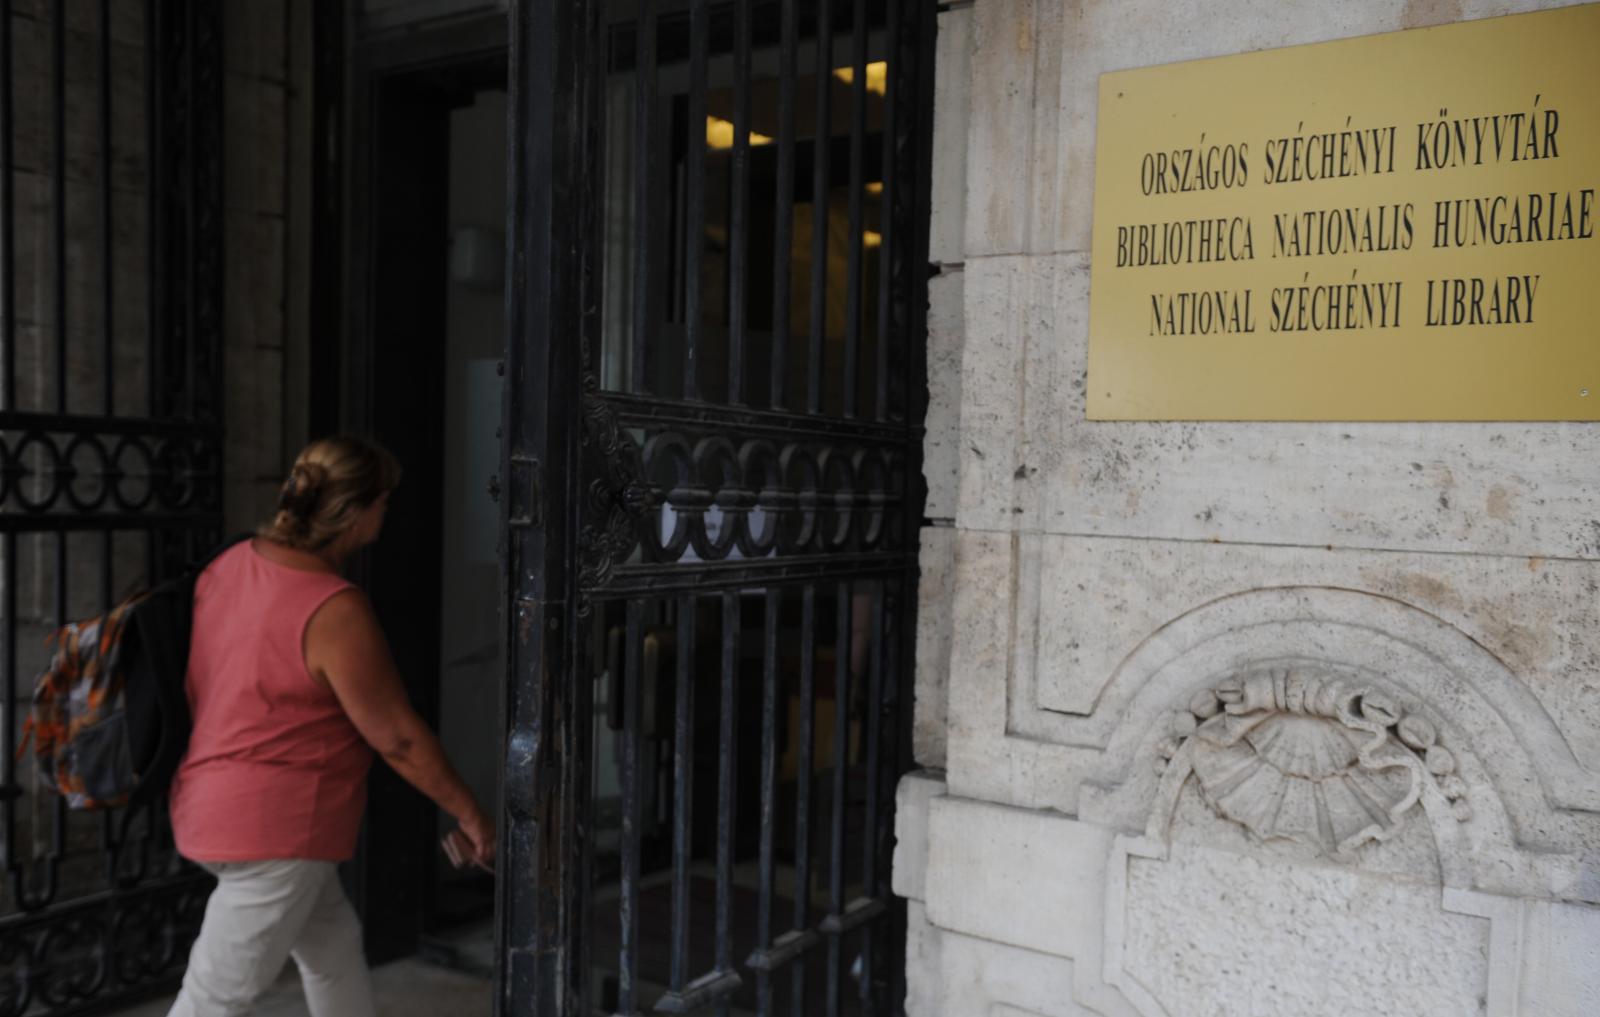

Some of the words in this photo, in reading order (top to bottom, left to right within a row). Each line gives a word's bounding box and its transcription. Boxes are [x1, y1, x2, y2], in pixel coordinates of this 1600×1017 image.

[1141, 132, 1248, 196] ORSZÁGOS
[1264, 116, 1397, 185] SZÉCHÉNYI
[1415, 94, 1560, 171] KÖNYVTÁR
[1116, 216, 1254, 268] BIBLIOTHECA
[1271, 202, 1414, 259] NATIONALIS
[1432, 189, 1594, 248] HUNGARIAE
[1149, 289, 1255, 336] NATIONAL
[1269, 268, 1402, 333] SZÉCHÉNYI
[1425, 275, 1541, 327] LIBRARY
